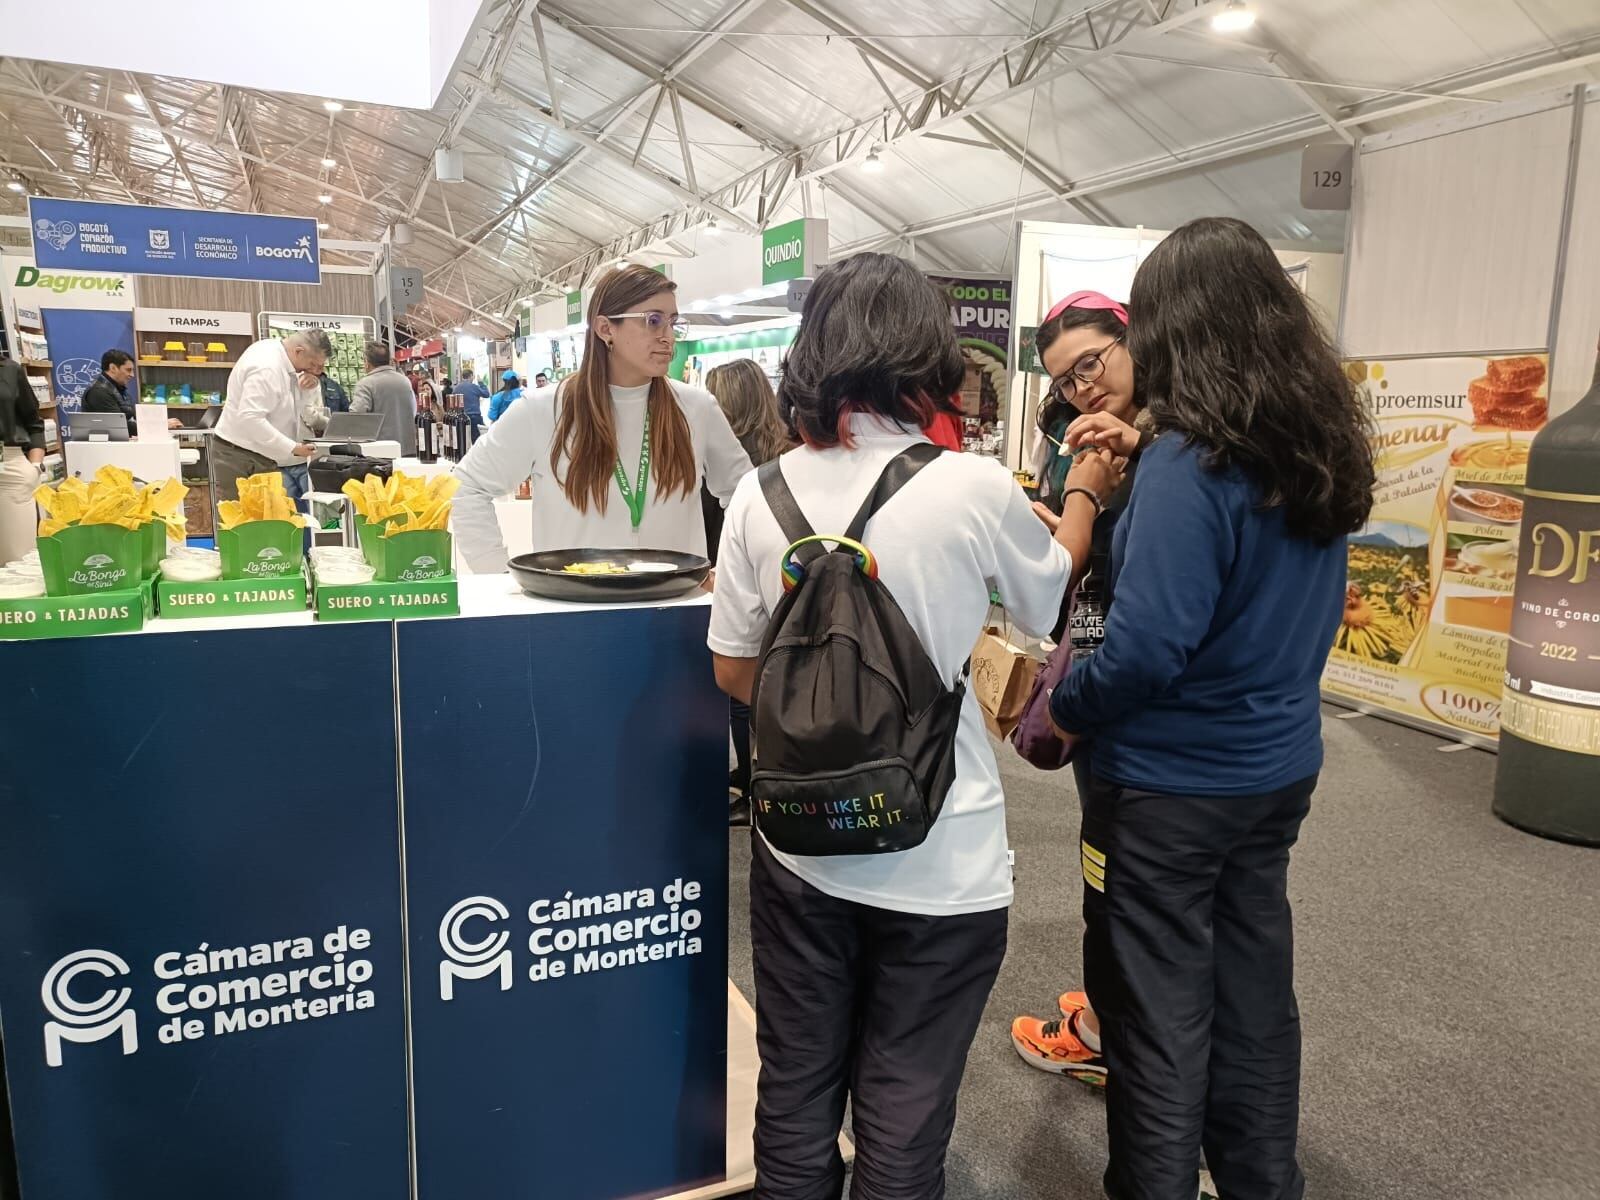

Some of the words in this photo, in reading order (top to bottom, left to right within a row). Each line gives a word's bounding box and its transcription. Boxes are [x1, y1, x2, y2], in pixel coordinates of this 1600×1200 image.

[1313, 171, 1342, 187] 129
[194, 242, 238, 252] DESARROLLO
[765, 235, 802, 268] QUINDÍO
[196, 251, 238, 260] ECONÓMICO
[15, 266, 121, 293] Dagrow
[401, 277, 413, 288] 15
[992, 287, 1010, 302] EL
[168, 317, 220, 327] TRAMPAS
[293, 320, 341, 329] SEMILLAS
[1473, 526, 1504, 536] Polen
[242, 561, 260, 574] La
[260, 561, 291, 573] Bonga
[69, 570, 89, 584] La
[88, 568, 127, 582] Bonga
[169, 592, 215, 606] SUERO
[234, 589, 295, 603] TAJADAS
[327, 596, 372, 609] SUERO
[390, 593, 448, 606] TAJADAS
[58, 606, 129, 622] TAJADAS
[1521, 601, 1541, 613] VINO
[1544, 607, 1560, 618] DE
[1540, 641, 1577, 662] 2022
[1446, 709, 1495, 730] Natural
[758, 799, 772, 814] IF
[777, 801, 817, 815] YOU
[824, 798, 862, 815] LIKE
[869, 793, 885, 810] IT
[827, 814, 881, 830] WEAR
[528, 890, 655, 924] Cámara
[662, 878, 701, 904] de
[528, 904, 702, 956] Comercio
[153, 941, 314, 980] Cámara
[323, 925, 371, 953] de
[528, 958, 566, 982] de
[573, 931, 702, 975] Montería
[156, 953, 374, 1015] Comercio
[158, 1017, 205, 1044] de
[214, 984, 376, 1035] Montería
